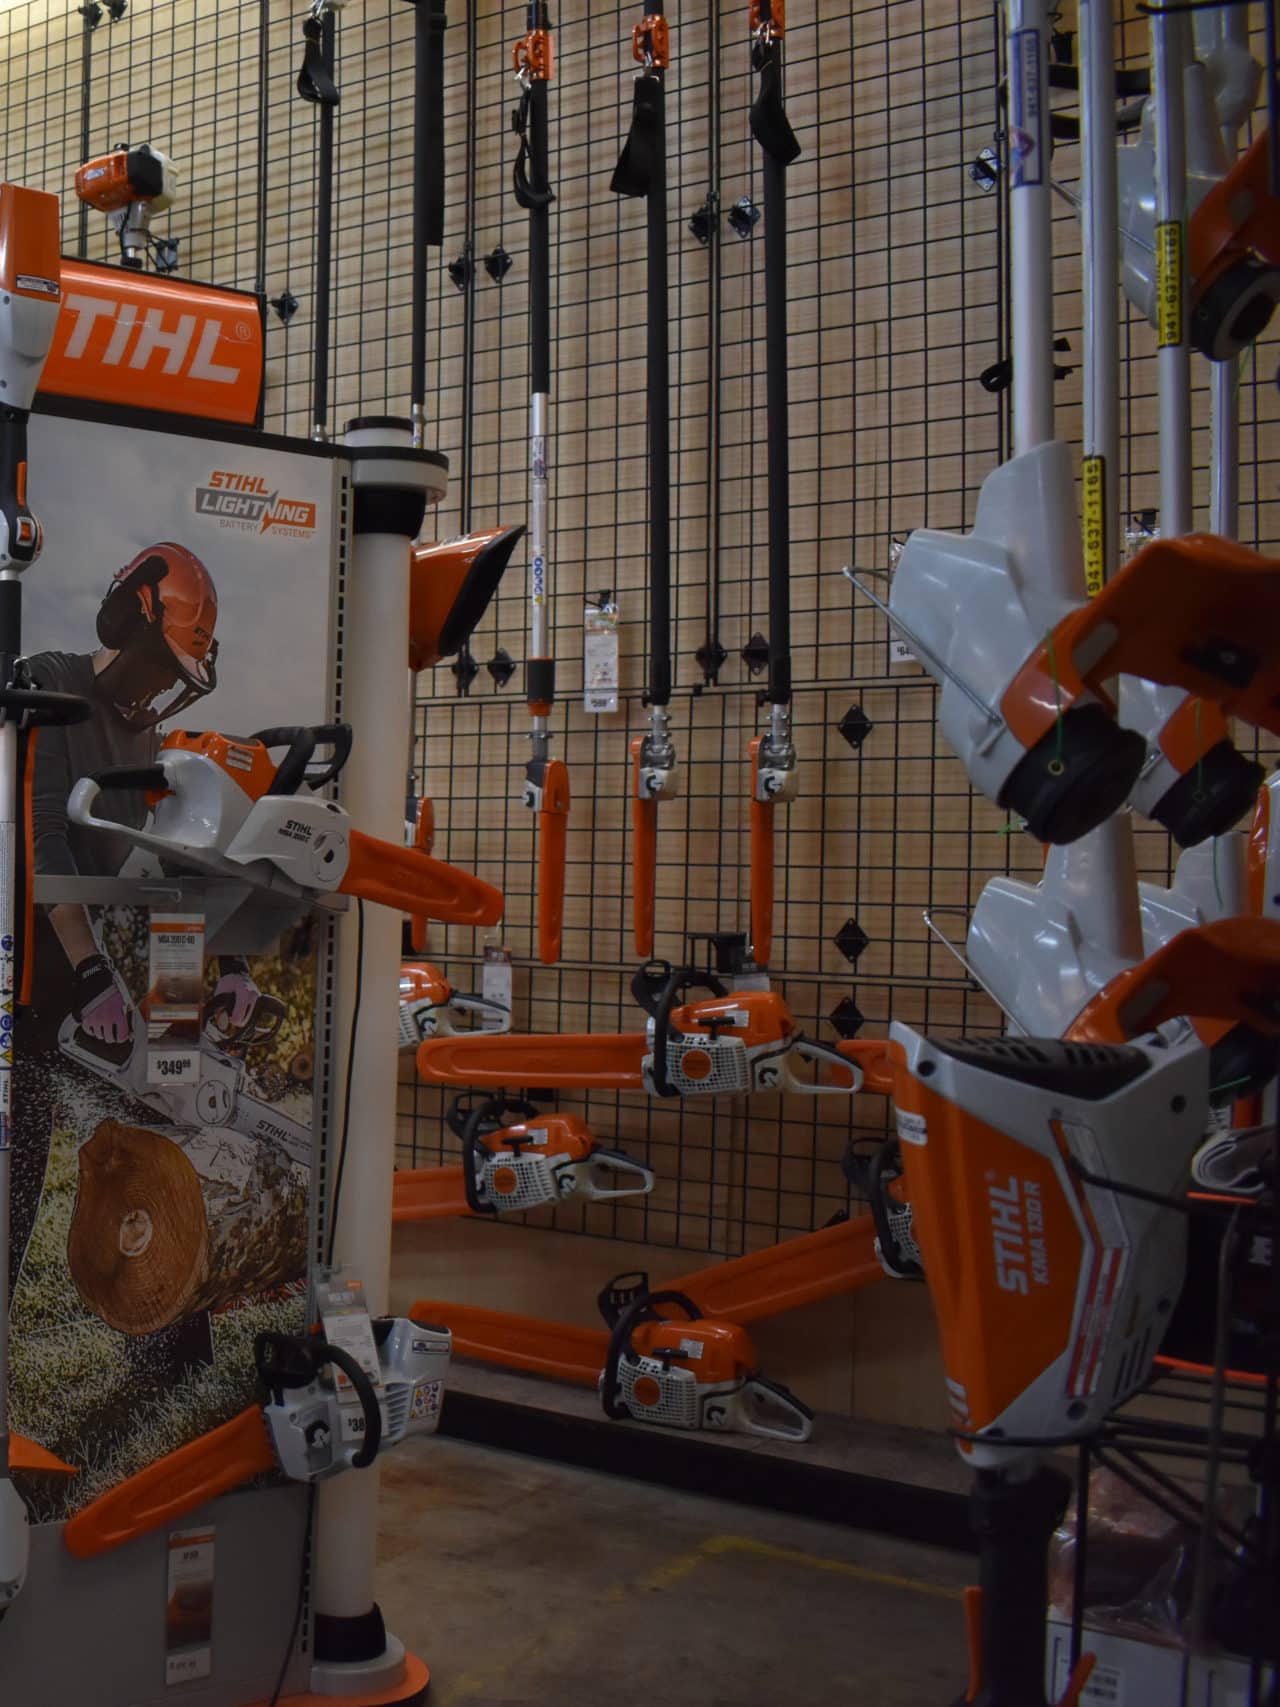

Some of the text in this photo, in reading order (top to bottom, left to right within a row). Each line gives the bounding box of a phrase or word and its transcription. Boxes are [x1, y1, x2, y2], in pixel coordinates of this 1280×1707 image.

[61, 291, 241, 384] TIHL
[208, 471, 269, 495] STIHL
[200, 492, 310, 524] LIGHTNING
[220, 518, 258, 531] BATTERY
[1087, 463, 1100, 592] 941-637-1165
[285, 820, 312, 836] STIHL
[257, 1120, 288, 1142] STIHL
[1023, 1180, 1041, 1196] R
[988, 1176, 1030, 1296] STIHL
[1030, 1239, 1049, 1285] KMA
